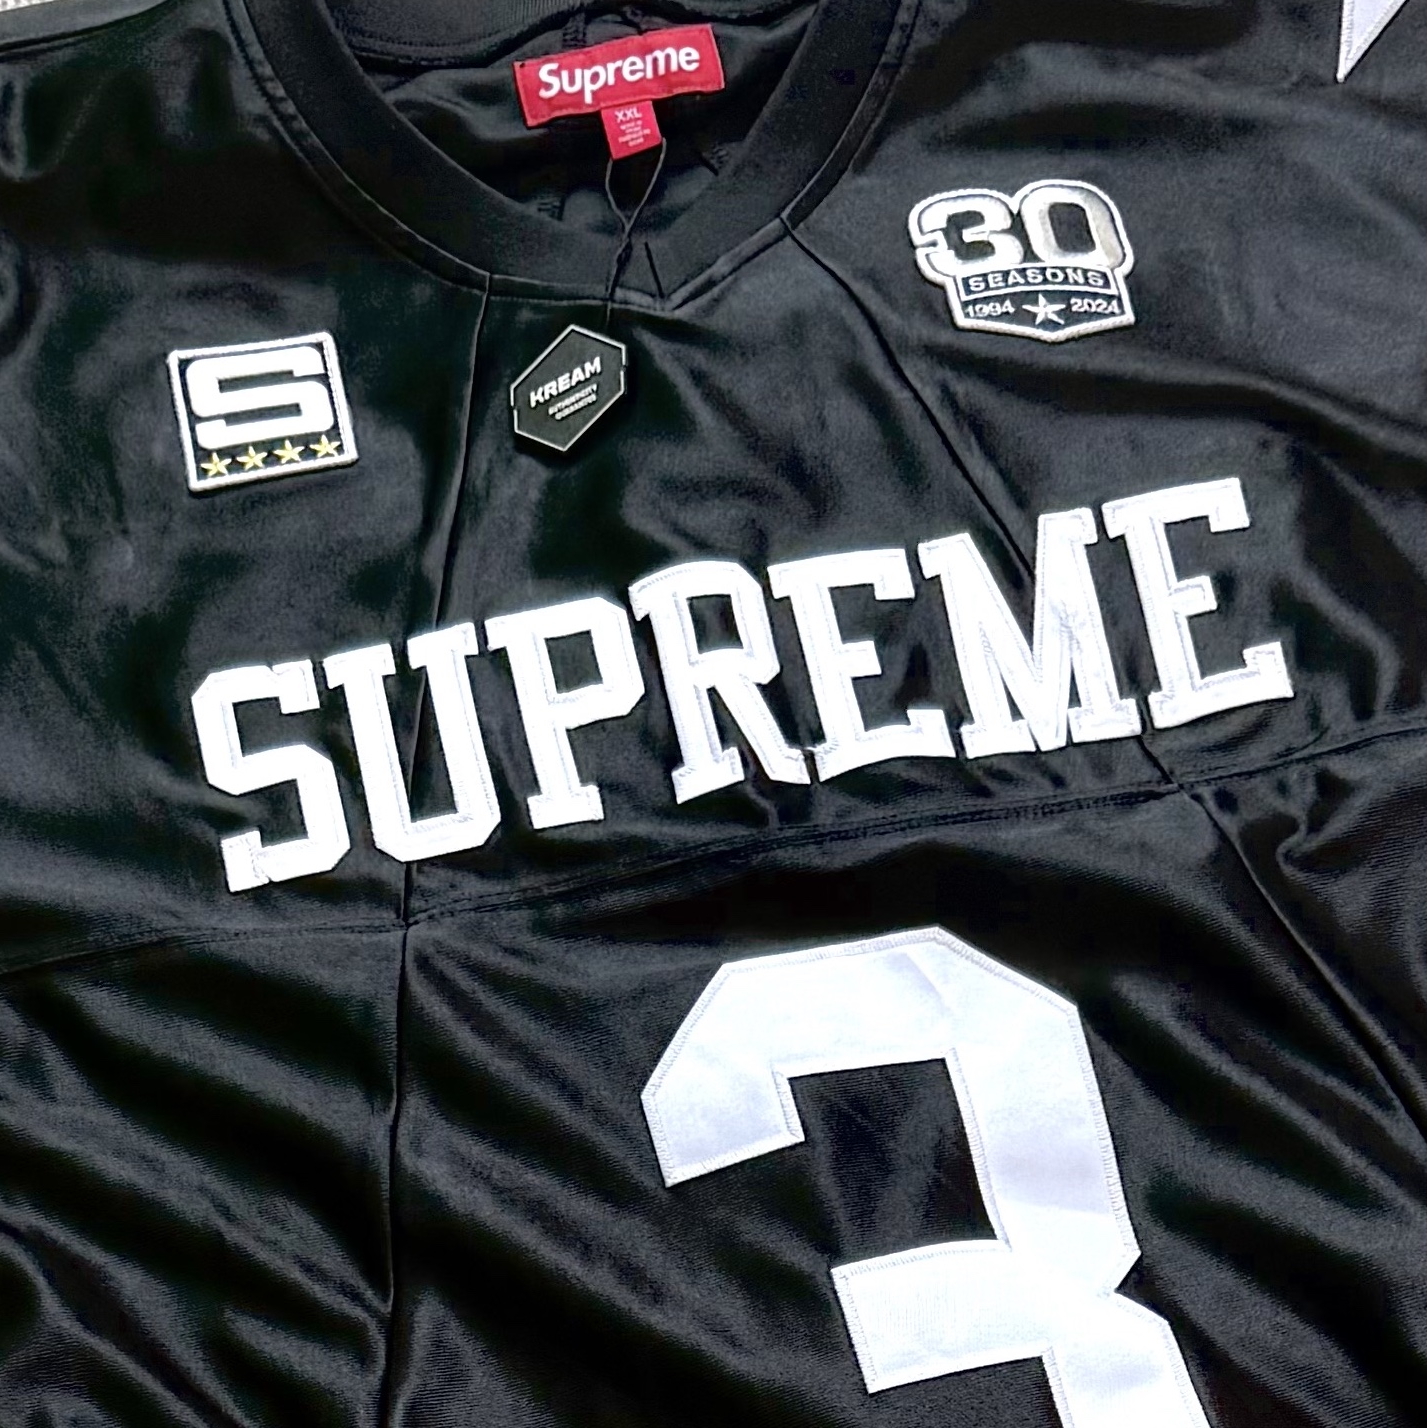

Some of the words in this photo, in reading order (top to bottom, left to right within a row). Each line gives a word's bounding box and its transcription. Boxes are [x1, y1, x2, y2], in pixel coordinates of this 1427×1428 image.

[538, 47, 700, 104] Supreme
[614, 107, 642, 123] XXL
[912, 180, 1132, 278] 30
[968, 266, 1104, 292] SEASONS
[965, 299, 1015, 318] 1994
[1070, 299, 1121, 315] 2024
[185, 346, 335, 450] S
[529, 356, 602, 408] KREAM
[189, 477, 1294, 892] SUPREME
